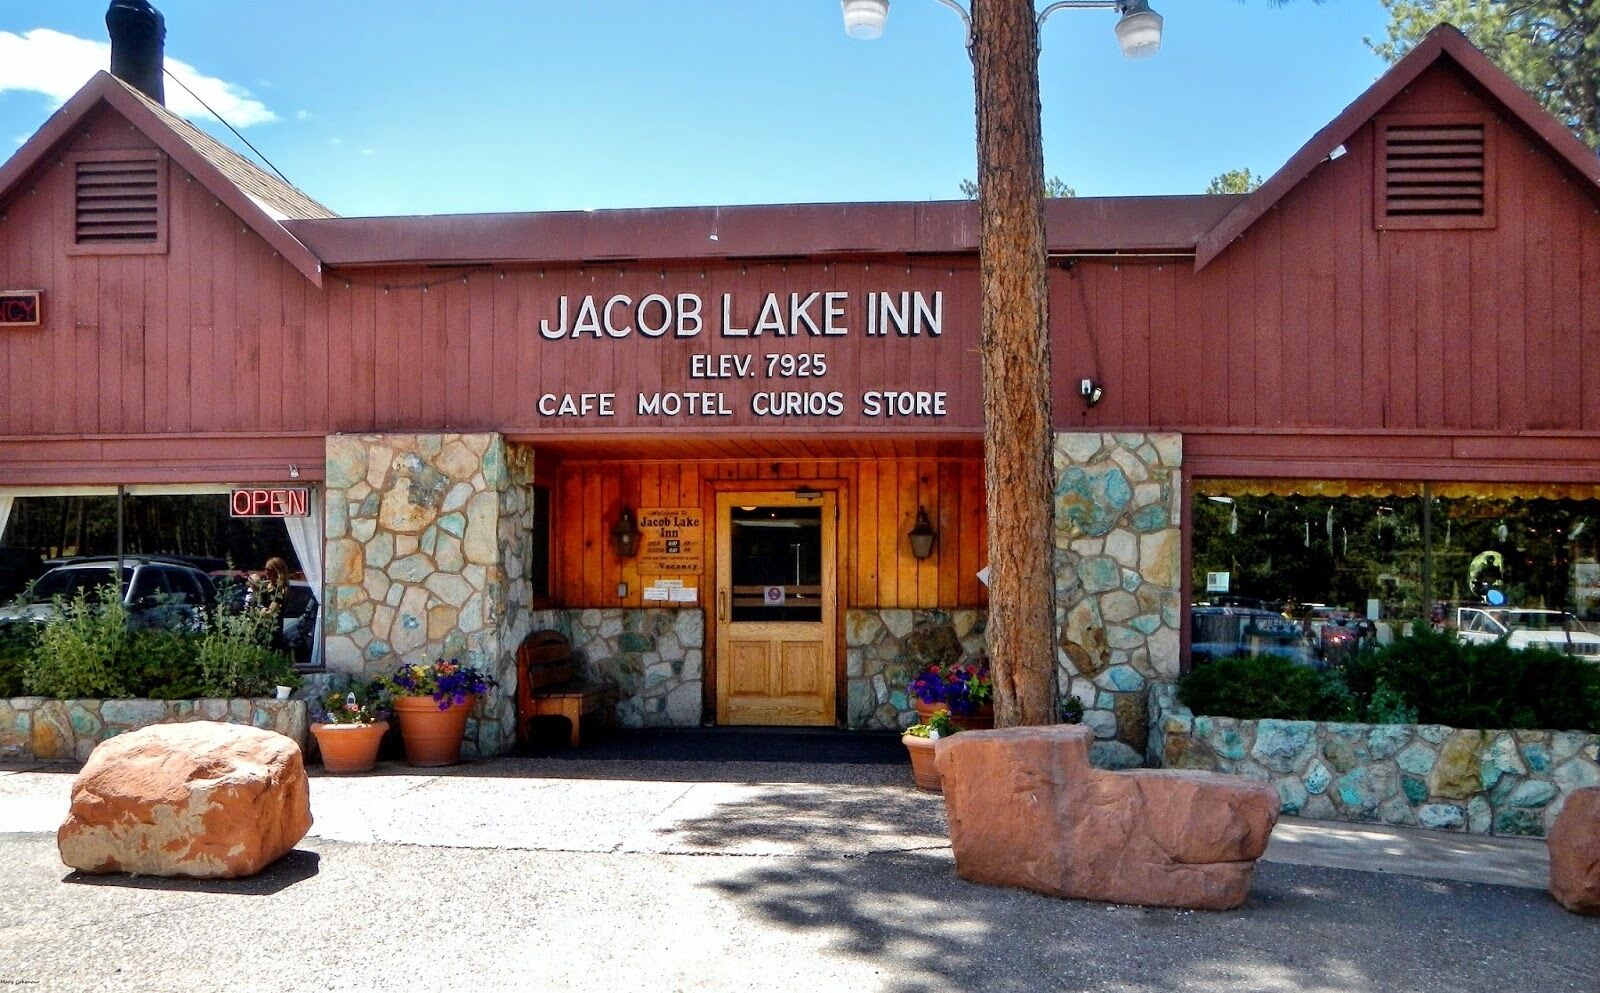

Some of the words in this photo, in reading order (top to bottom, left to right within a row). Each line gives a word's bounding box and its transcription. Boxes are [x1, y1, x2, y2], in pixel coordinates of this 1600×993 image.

[540, 293, 703, 339] JACOB
[723, 291, 850, 337] LAKE
[866, 290, 943, 336] INN
[691, 353, 755, 378] ELEV.
[766, 353, 827, 378] 7925
[538, 393, 616, 417] CAFE
[637, 392, 733, 416] MOTEL
[752, 391, 845, 417] CURIOS
[863, 391, 947, 416] STORE
[233, 490, 305, 515] OPEN
[640, 516, 671, 527] Jacob
[673, 516, 700, 527] Lake
[660, 527, 679, 538] Inn
[659, 562, 698, 571] Vacancy
